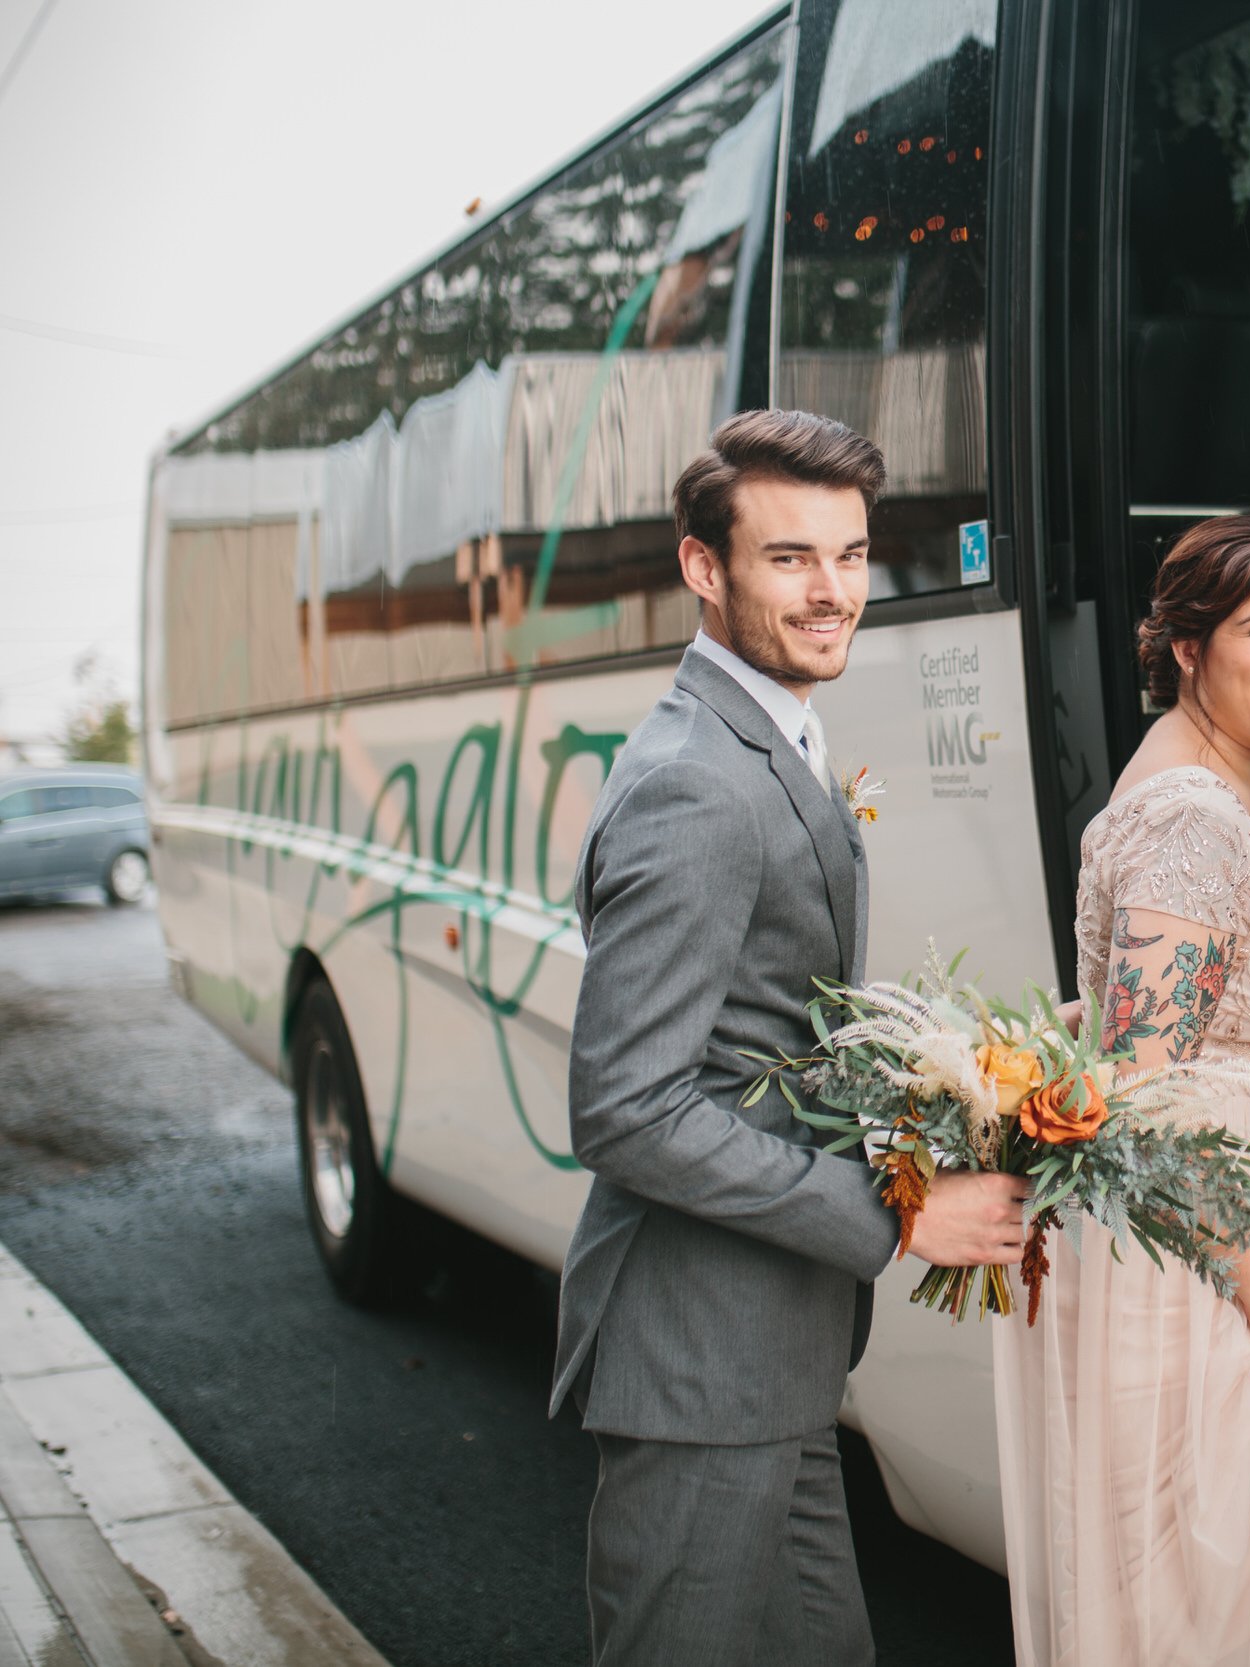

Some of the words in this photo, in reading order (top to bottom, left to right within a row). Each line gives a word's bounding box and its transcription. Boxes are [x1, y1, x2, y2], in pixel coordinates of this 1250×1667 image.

[920, 645, 979, 678] Certified
[922, 679, 981, 709] Member
[926, 711, 988, 767] IMG
